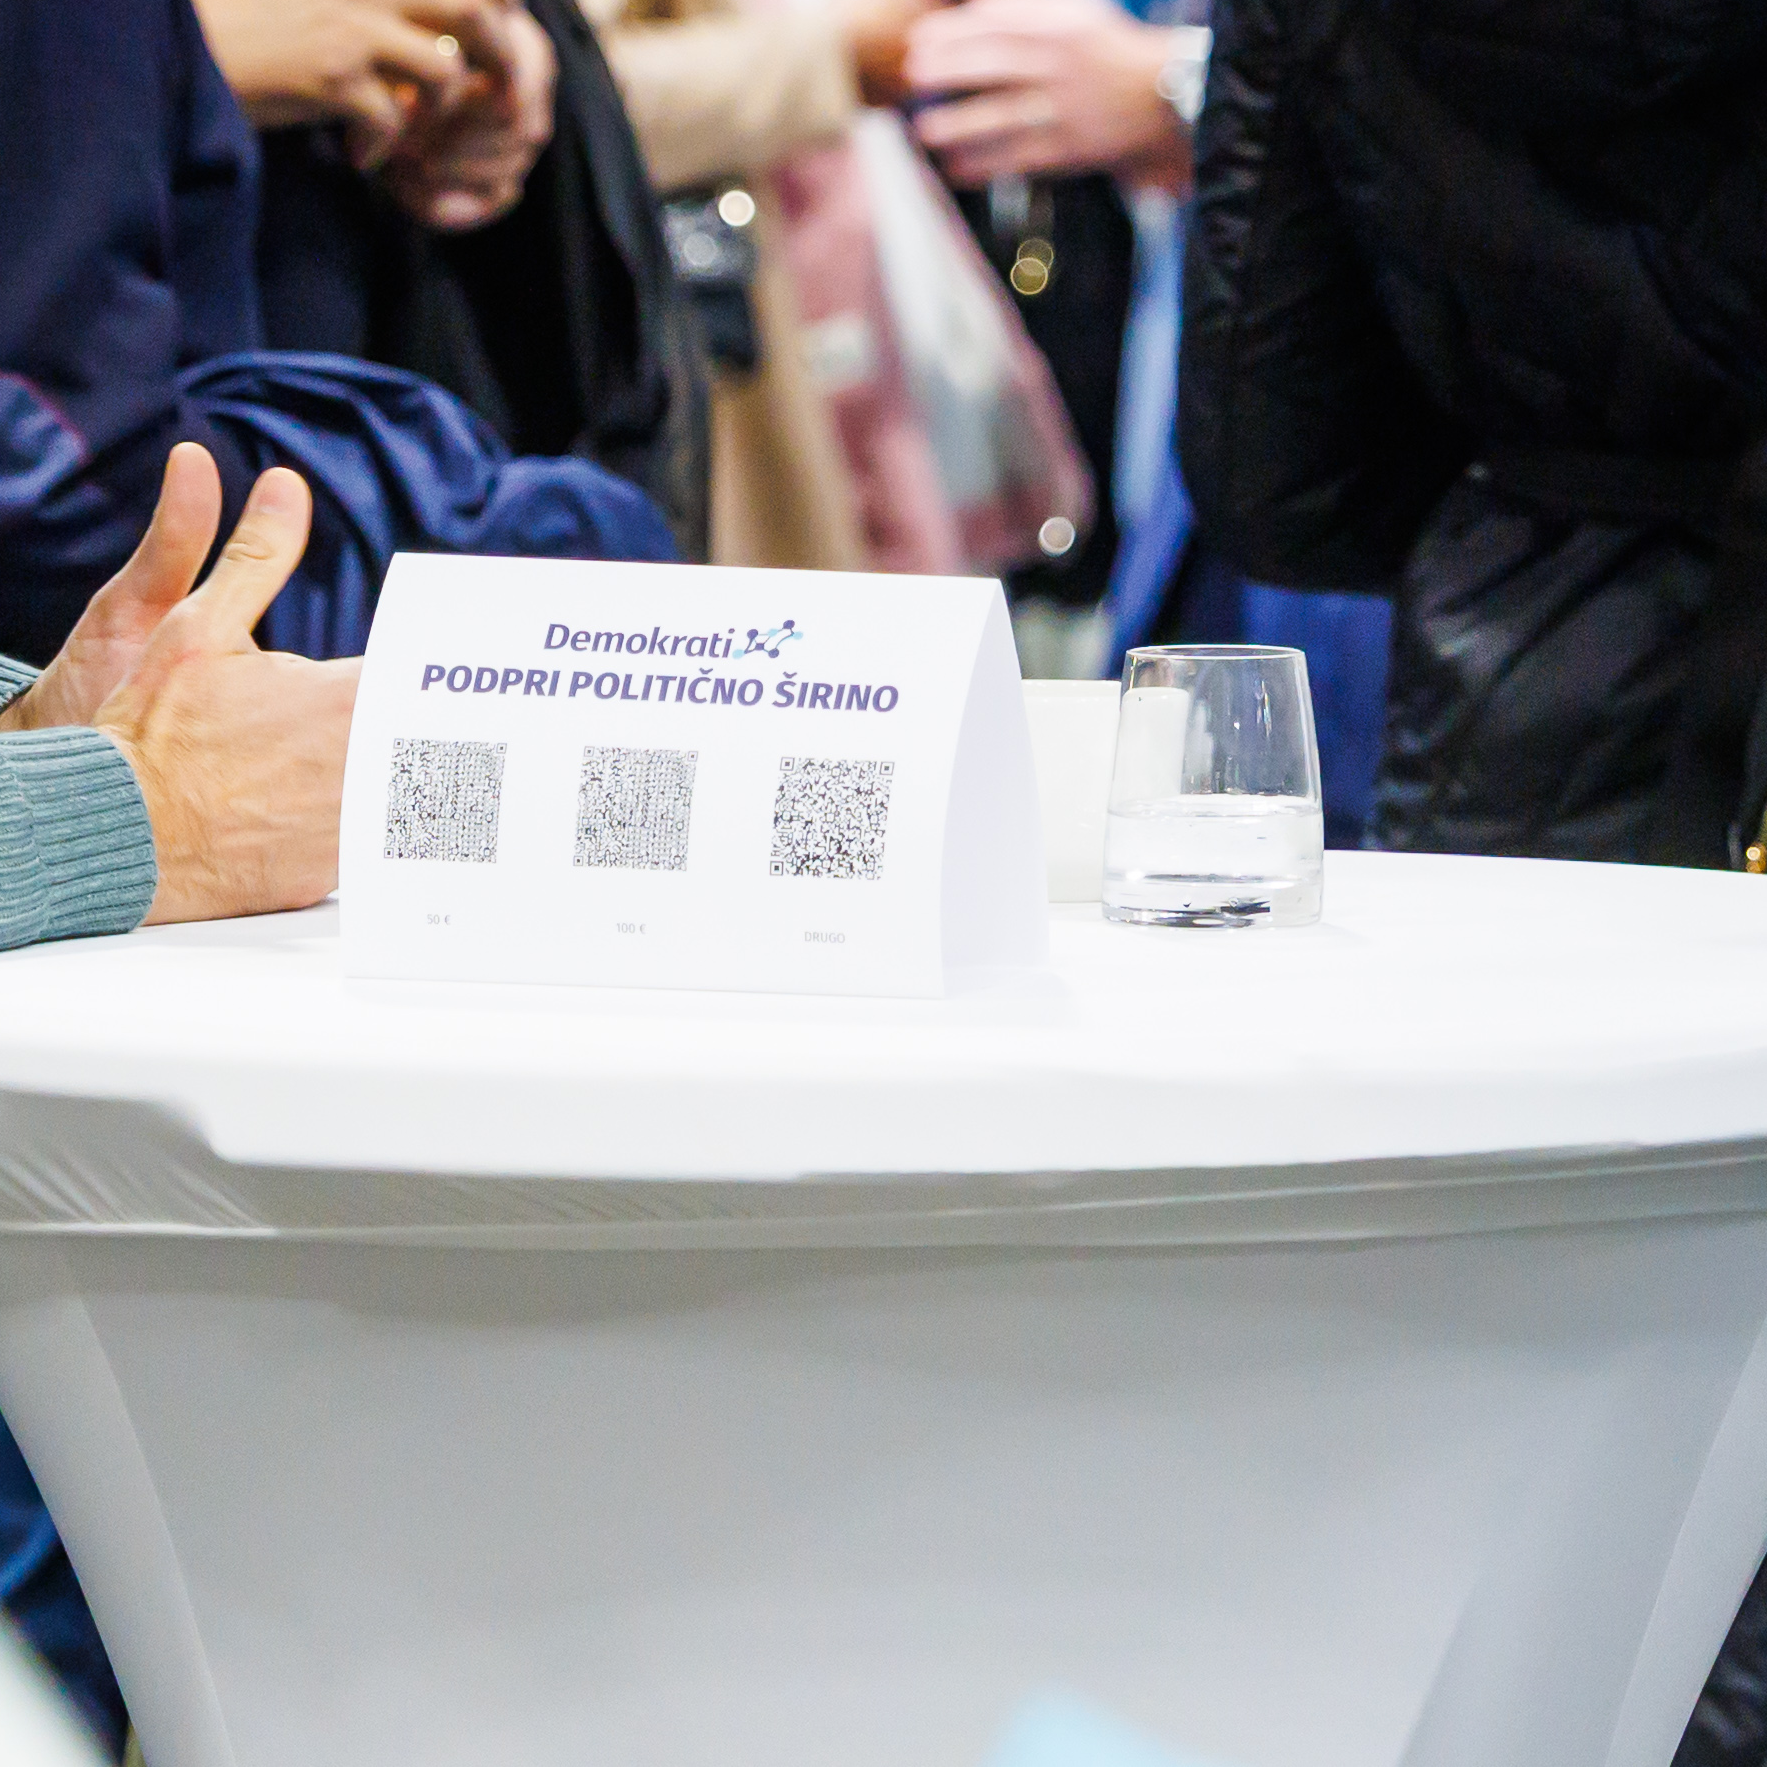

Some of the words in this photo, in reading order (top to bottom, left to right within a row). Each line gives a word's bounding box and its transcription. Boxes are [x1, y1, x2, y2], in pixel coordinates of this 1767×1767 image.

[543, 622, 736, 659] Demokrati
[421, 663, 561, 697] PODPRI
[568, 666, 764, 707] POLITIČNO
[772, 671, 900, 713] ŠIRINO
[427, 914, 441, 925] 50
[616, 923, 636, 934] 100
[803, 930, 847, 945] DRUGO
